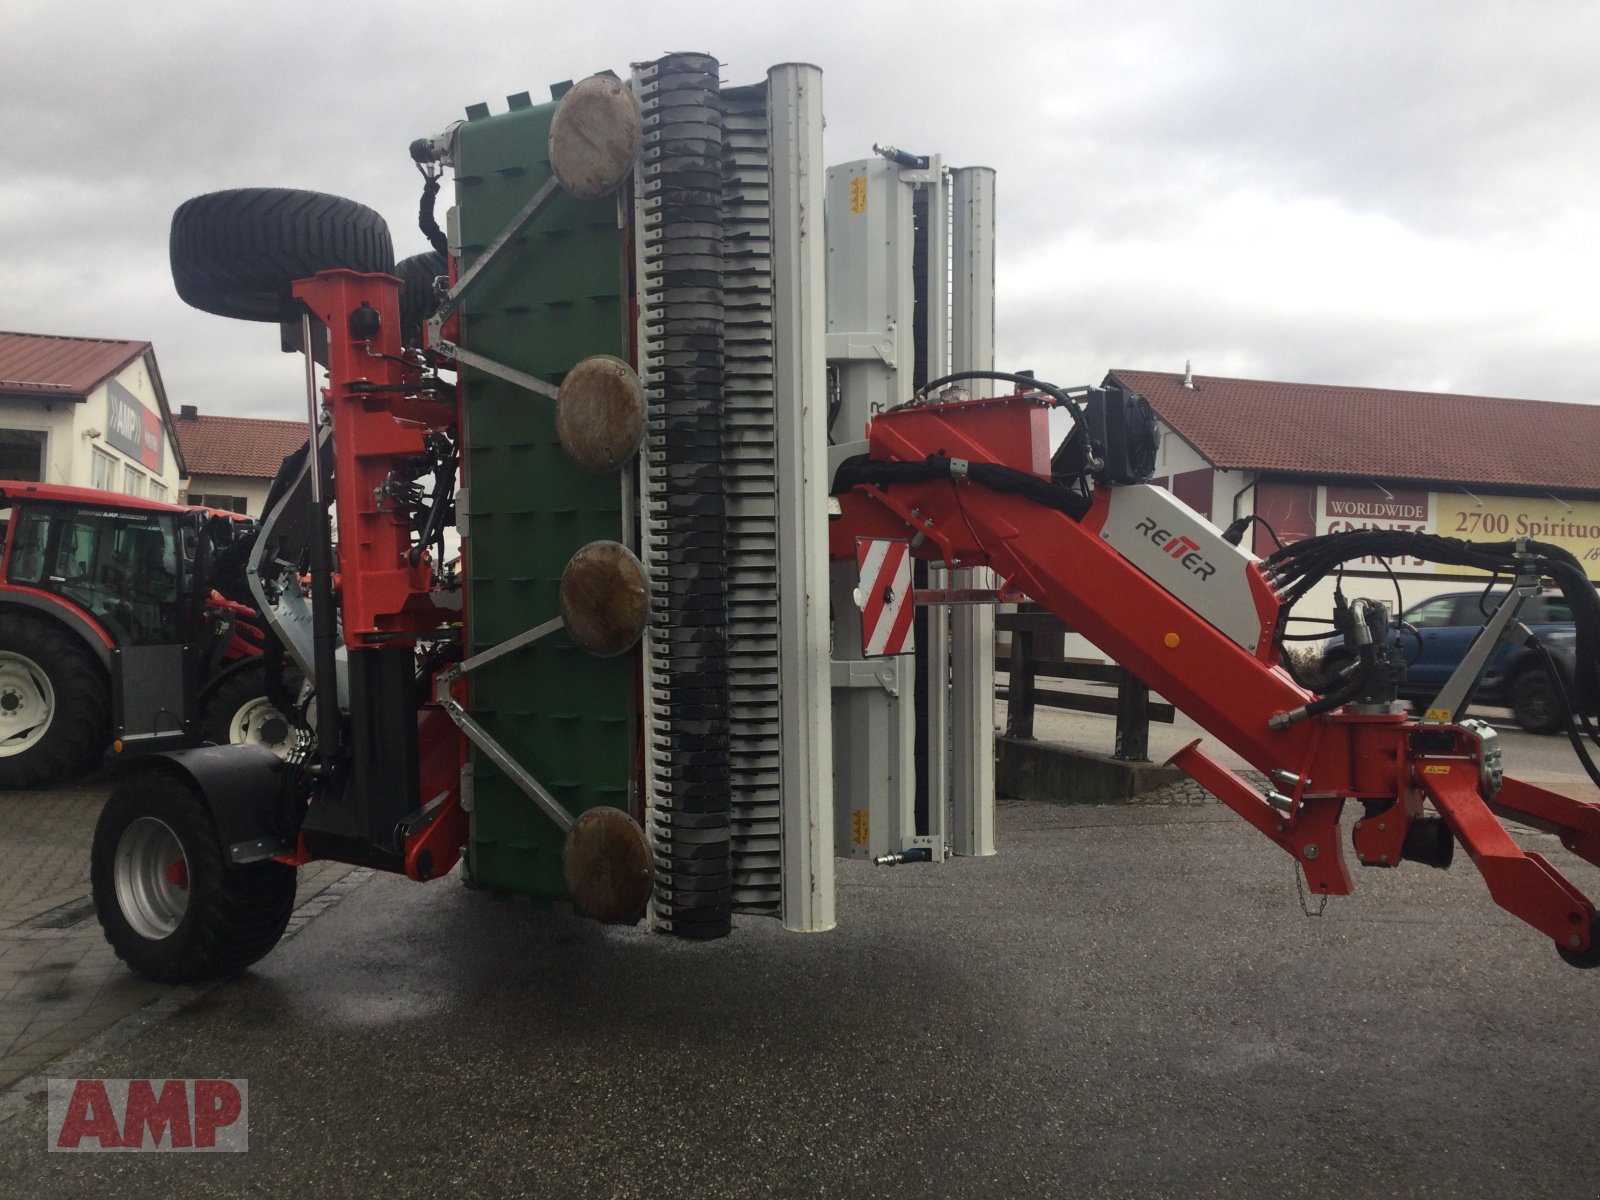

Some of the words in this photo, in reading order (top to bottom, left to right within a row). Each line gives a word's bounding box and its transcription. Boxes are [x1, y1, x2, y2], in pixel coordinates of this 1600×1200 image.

[116, 400, 137, 441] AMP
[1331, 501, 1424, 518] WORLDWIDE
[1455, 511, 1510, 535] 2700
[1515, 513, 1600, 539] Spirituo
[1135, 516, 1216, 582] REITER
